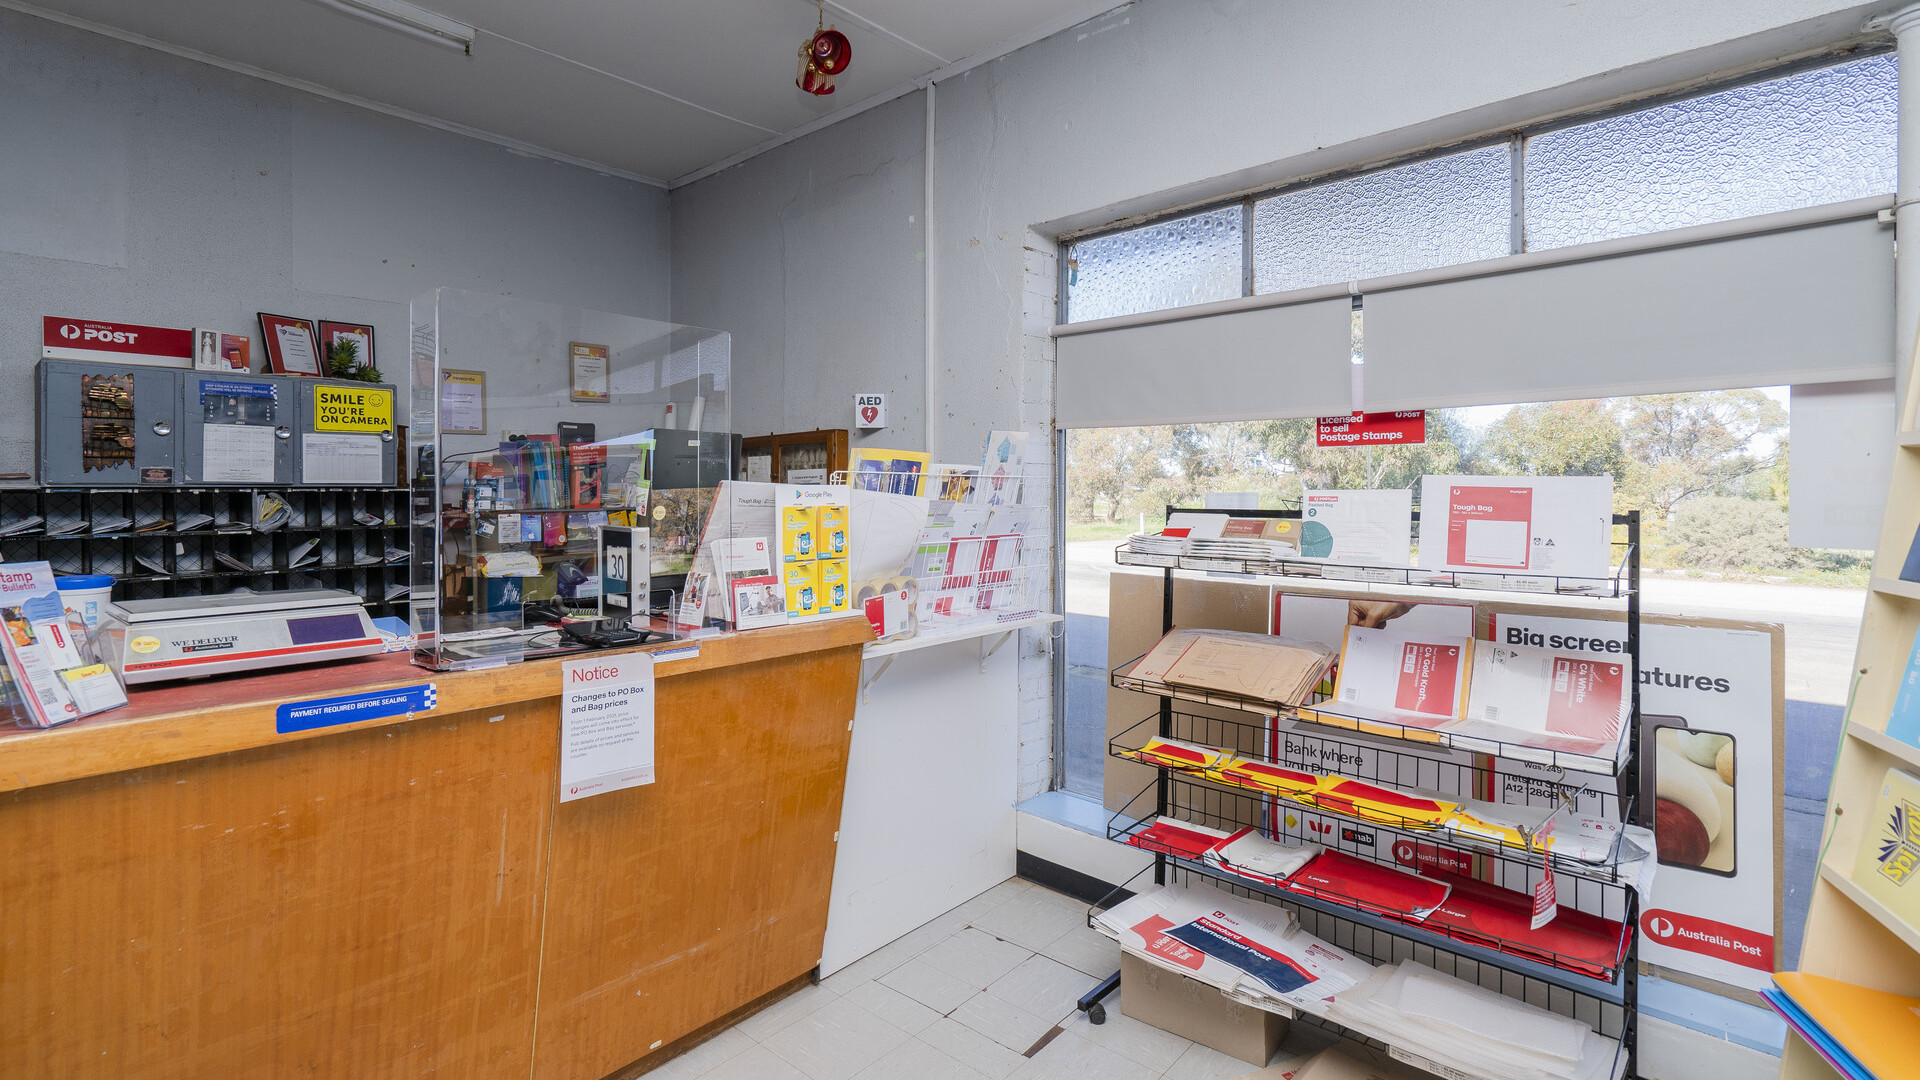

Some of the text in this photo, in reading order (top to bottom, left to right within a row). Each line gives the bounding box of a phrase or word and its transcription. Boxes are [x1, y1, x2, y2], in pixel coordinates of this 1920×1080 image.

[84, 328, 138, 344] POST
[321, 393, 364, 405] SMILE
[858, 397, 882, 406] AED
[321, 406, 364, 415] YOU'RE
[321, 415, 388, 425] ON CAMERA
[1320, 414, 1363, 424] Licensed
[1333, 424, 1349, 432] sell
[1320, 431, 1403, 442] Postage Stamps
[805, 490, 832, 499] Google Play
[611, 554, 625, 579] 30
[0, 572, 33, 584] tamp
[2, 582, 36, 592] Bulletin
[192, 636, 238, 645] DELIVER
[1506, 627, 1544, 648] Big
[572, 666, 618, 683] Notice
[1418, 647, 1432, 701] C4 Gold Kraft
[1576, 663, 1588, 703] C4 White
[1640, 667, 1730, 694] atures
[572, 692, 606, 703] Changes
[618, 688, 628, 696] PO
[290, 696, 407, 718] PAYMENT REQUIRED BEFORE SEALING
[572, 705, 586, 713] and
[605, 700, 628, 709] prices
[1285, 741, 1363, 766] Bank where
[1524, 762, 1562, 774] Was 249
[1506, 783, 1524, 793] A12
[1545, 780, 1596, 798] Samsng
[1355, 834, 1372, 843] nab
[1416, 852, 1467, 870] Australia Post
[1308, 876, 1329, 884] Large
[1441, 908, 1466, 918] Large
[1224, 917, 1240, 926] POST
[1199, 918, 1242, 940] Standard
[1191, 922, 1272, 962] International Post
[1678, 927, 1762, 957] Australia Post
